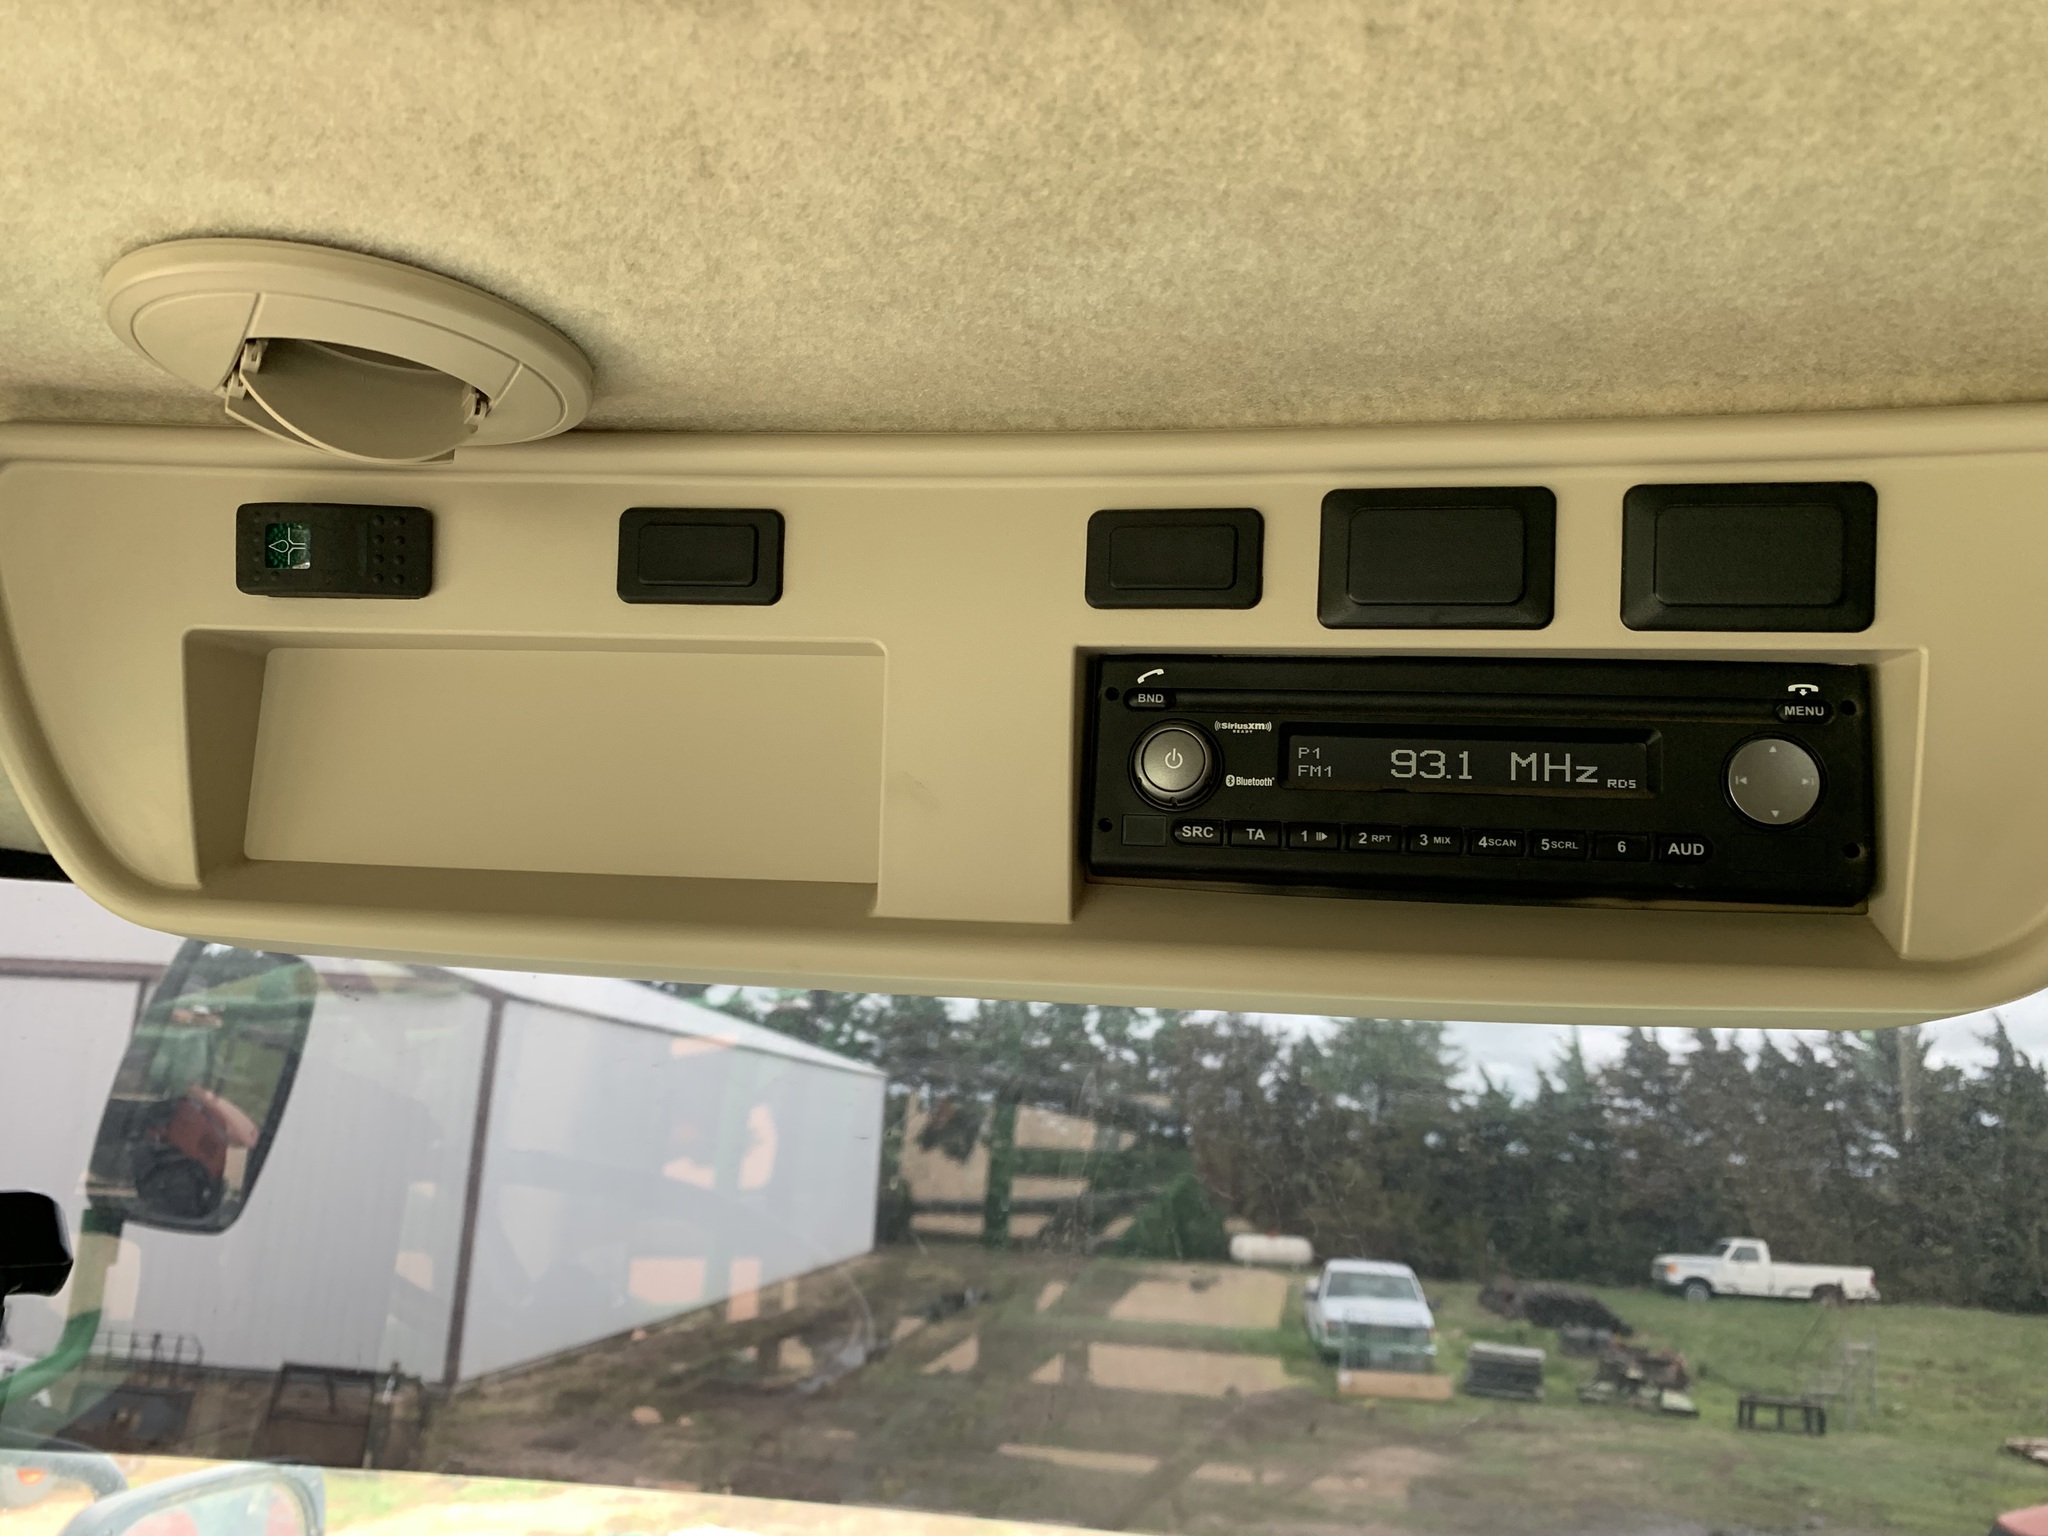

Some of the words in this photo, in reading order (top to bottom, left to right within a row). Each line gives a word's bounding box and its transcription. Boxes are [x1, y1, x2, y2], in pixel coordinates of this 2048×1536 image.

[1137, 693, 1164, 704] BND
[1784, 705, 1825, 717] MENU
[1298, 746, 1320, 760] P1
[1297, 764, 1332, 778] FM1
[1391, 749, 1473, 780] 93.1
[1510, 751, 1599, 784] MHz
[1236, 776, 1273, 787] Bluetooth
[1607, 778, 1637, 789] RDS
[1181, 825, 1214, 838] SRC
[1245, 828, 1266, 841] TA
[1301, 830, 1308, 842] 1
[1358, 832, 1368, 845] 2
[1371, 834, 1392, 843] RPT
[1419, 833, 1429, 846] 3
[1433, 836, 1451, 845] MIX
[1617, 840, 1627, 853] 6
[1667, 842, 1705, 856] AUD
